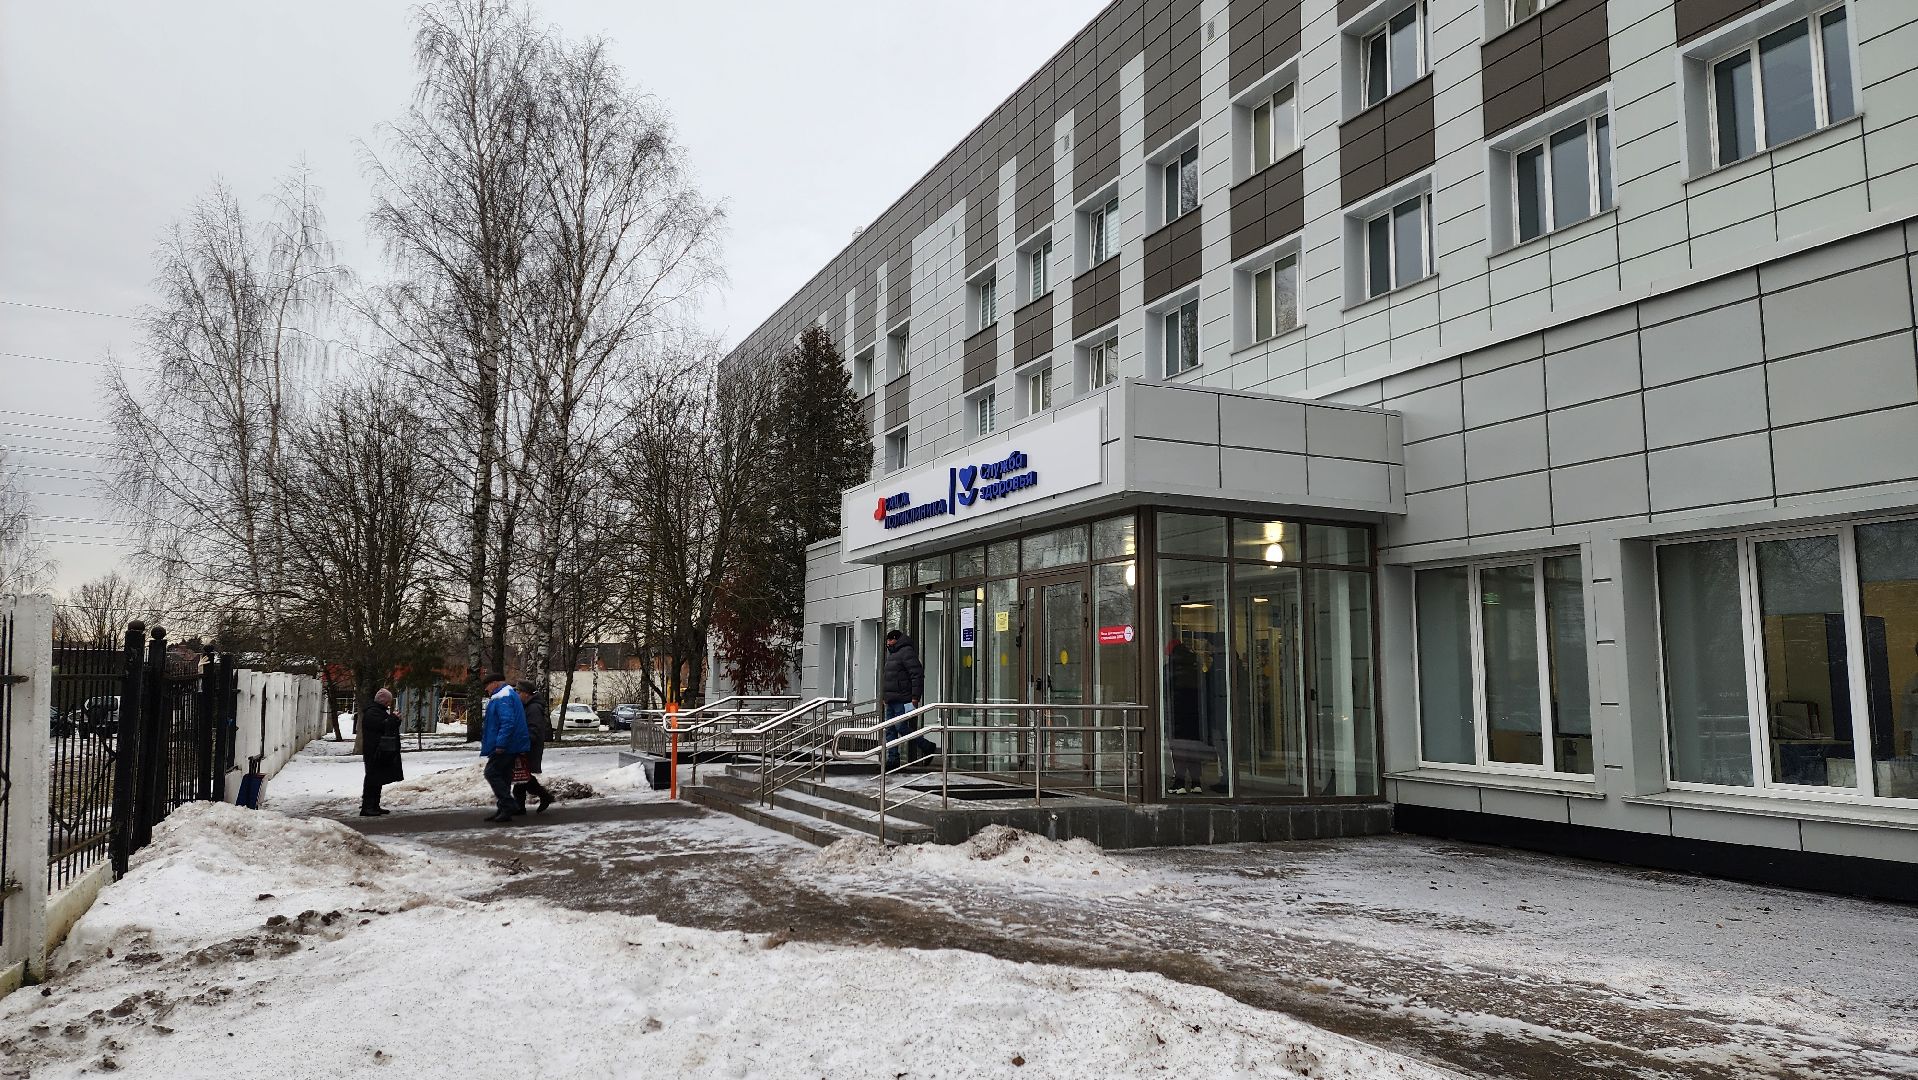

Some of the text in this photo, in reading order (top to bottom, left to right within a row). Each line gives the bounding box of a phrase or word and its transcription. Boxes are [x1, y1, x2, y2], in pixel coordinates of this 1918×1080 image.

[980, 451, 1027, 480] Служба
[980, 471, 1037, 501] здоровья
[884, 499, 947, 529] ПОЛИКЛИНИКА
